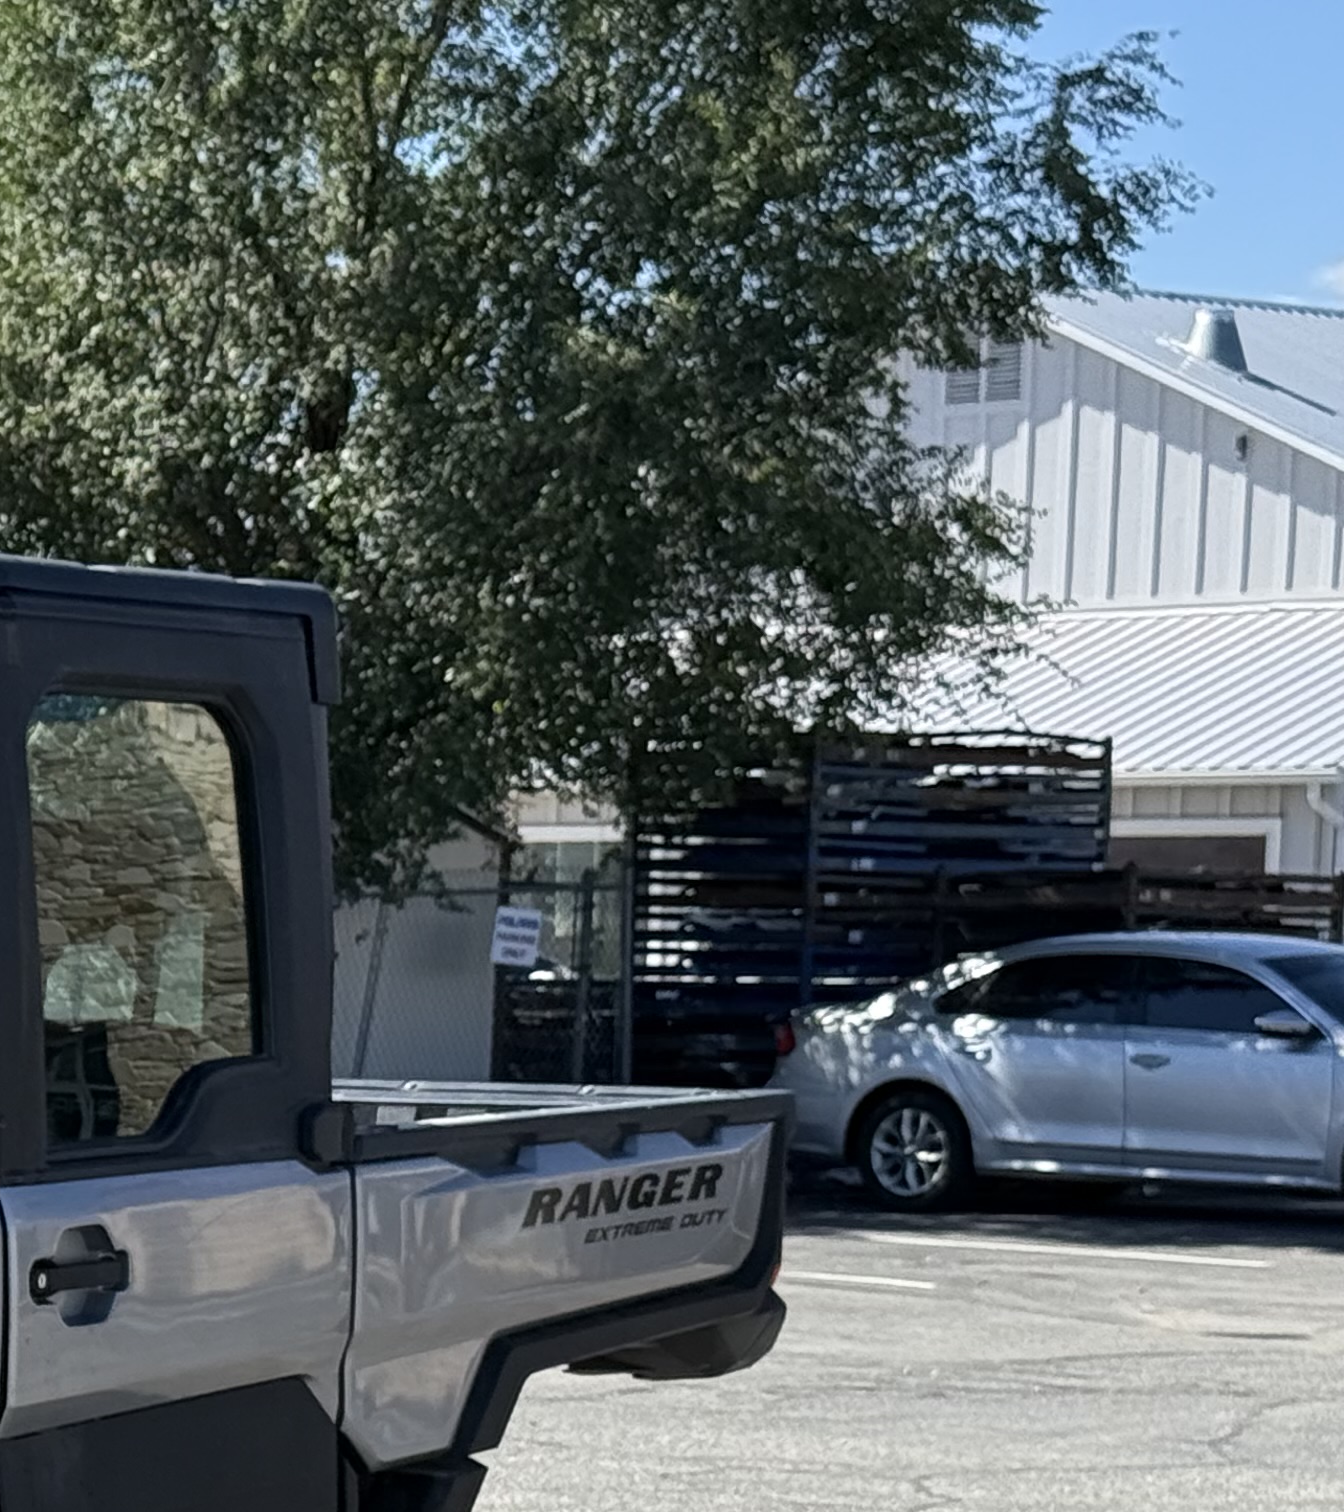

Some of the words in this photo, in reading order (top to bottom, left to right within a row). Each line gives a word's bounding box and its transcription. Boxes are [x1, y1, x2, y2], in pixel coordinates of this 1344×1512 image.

[521, 1163, 723, 1229] RANGER
[584, 1215, 675, 1244] EXTREME
[679, 1207, 729, 1229] DUTY
